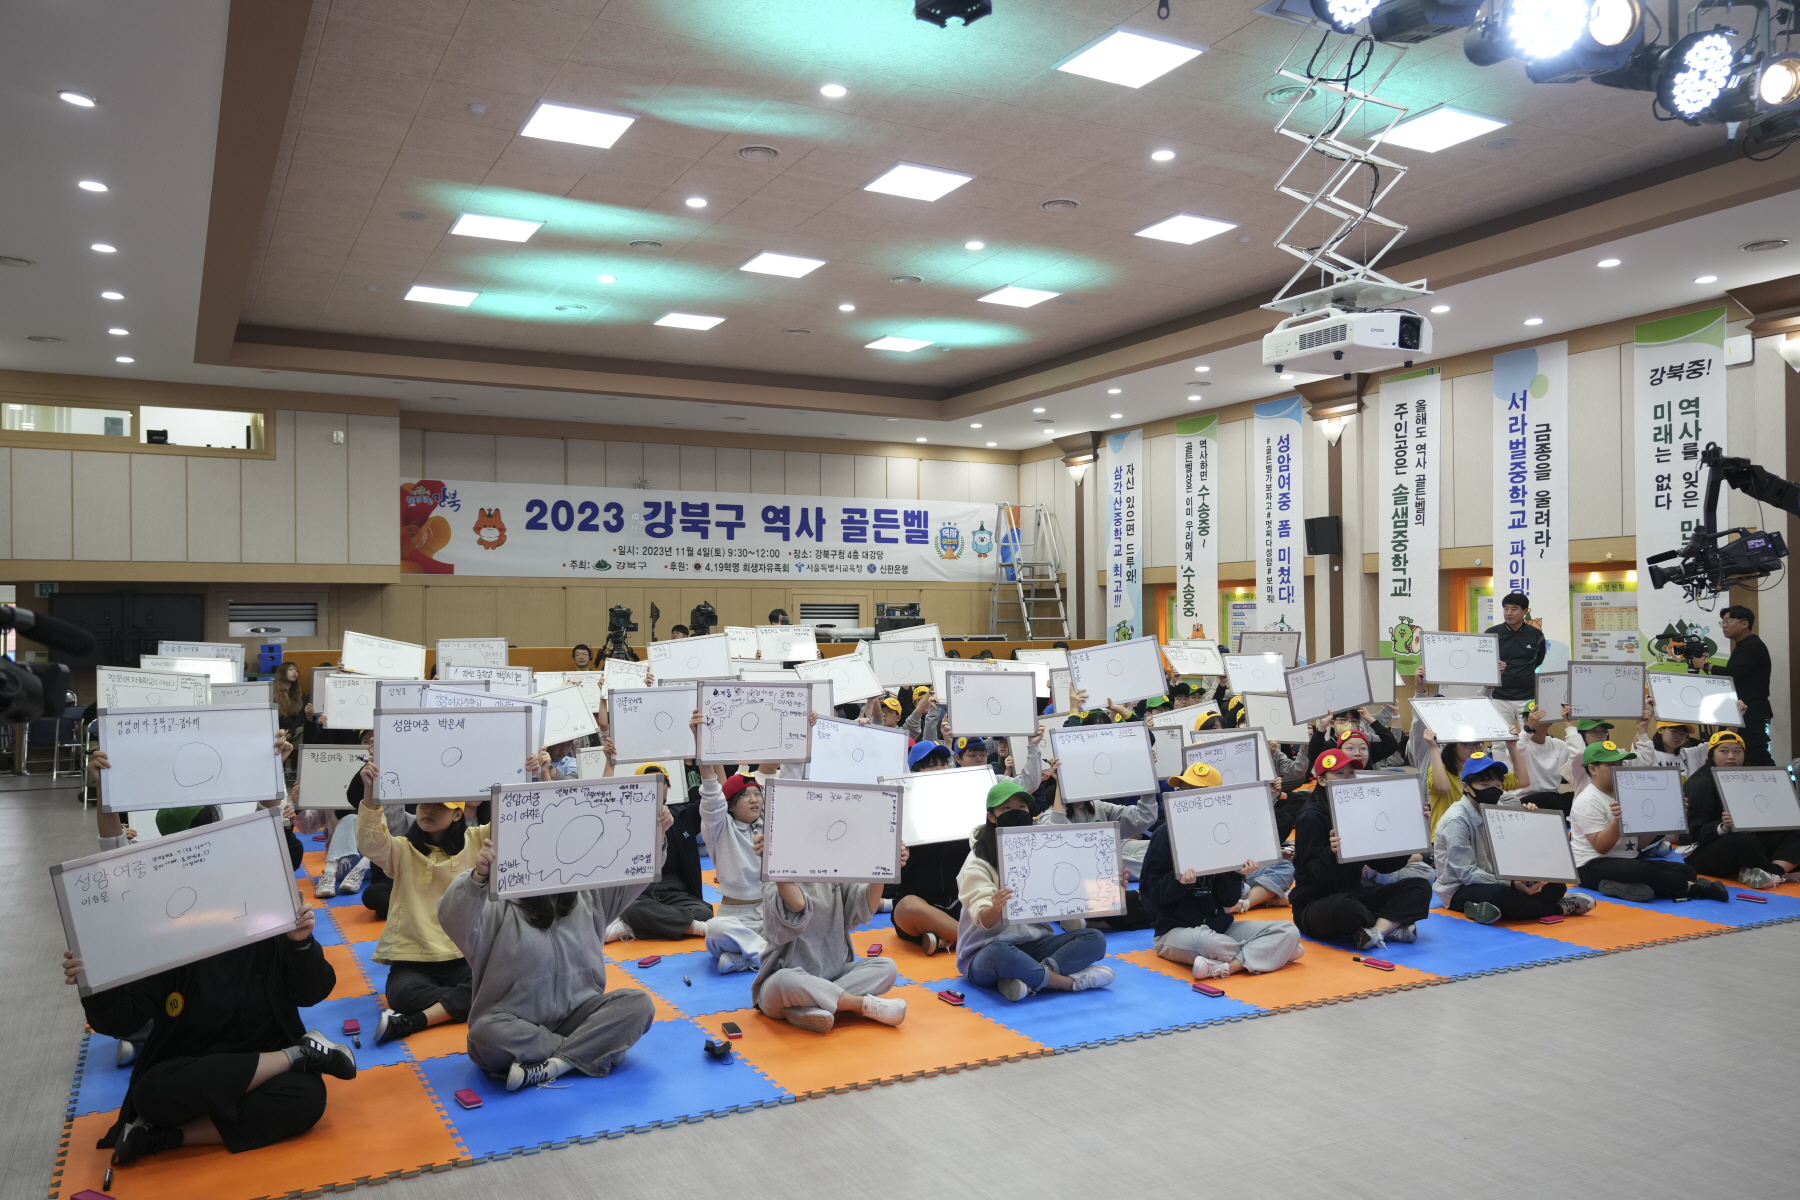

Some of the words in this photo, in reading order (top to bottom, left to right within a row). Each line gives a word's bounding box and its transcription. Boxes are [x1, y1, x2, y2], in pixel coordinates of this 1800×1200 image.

[1650, 359, 1712, 386] 강북중!
[1394, 403, 1408, 475] 주인공은
[1415, 399, 1427, 439] 올해도
[1653, 400, 1673, 464] 미래는
[1679, 397, 1702, 460] 역사를
[1184, 442, 1193, 493] 골든벨상은
[1199, 439, 1208, 481] 역사하면
[1415, 443, 1427, 470] 역사
[1508, 390, 1528, 530] 서라벌중학교
[1534, 423, 1552, 481] 금종을
[1126, 463, 1135, 490] 자신
[1277, 434, 1291, 511] 성암여중
[1655, 473, 1673, 511] 없다
[1682, 471, 1700, 508] 잊은
[432, 487, 461, 512] 강북
[1113, 466, 1123, 557] 삼각산중학교
[1126, 496, 1135, 536] 있으면
[1185, 497, 1193, 517] 이미
[1415, 474, 1426, 526] 골든벨의
[525, 499, 625, 533] 2023
[643, 501, 746, 540] 강북구
[761, 505, 826, 542] 역사
[841, 508, 929, 544] 골든벨
[1184, 520, 1193, 562] 우리에게
[1277, 520, 1291, 538] 폼
[1390, 483, 1412, 597] 솔샘중학교!
[1534, 490, 1552, 559] 울려라~
[570, 560, 590, 570] 주최:
[616, 561, 647, 570] 강북구
[618, 545, 639, 555] 일시:
[642, 546, 672, 557] 2023년
[675, 547, 694, 557] 11월
[697, 547, 726, 558] 4일(토)
[728, 548, 780, 559] 9:30~12:00
[669, 561, 689, 571] 후원:
[705, 562, 740, 572] 4.19혁명
[742, 562, 789, 573] 희생자유족회
[793, 549, 812, 559] 장소:
[815, 550, 845, 560] 강북구청
[847, 550, 860, 560] 4층
[862, 550, 884, 560] 대강당
[806, 563, 863, 574] 서울특별시교육청
[880, 564, 908, 575] 신한은행
[1126, 543, 1137, 584] 드루와!
[1509, 540, 1530, 595] 파이팅!
[1113, 563, 1123, 608] 최고!!!
[1278, 547, 1294, 604] 미쳤다!
[393, 719, 431, 733] 성암여중
[438, 718, 465, 731] 박은세
[502, 791, 541, 807] 성암여중
[169, 998, 178, 1010] 10
